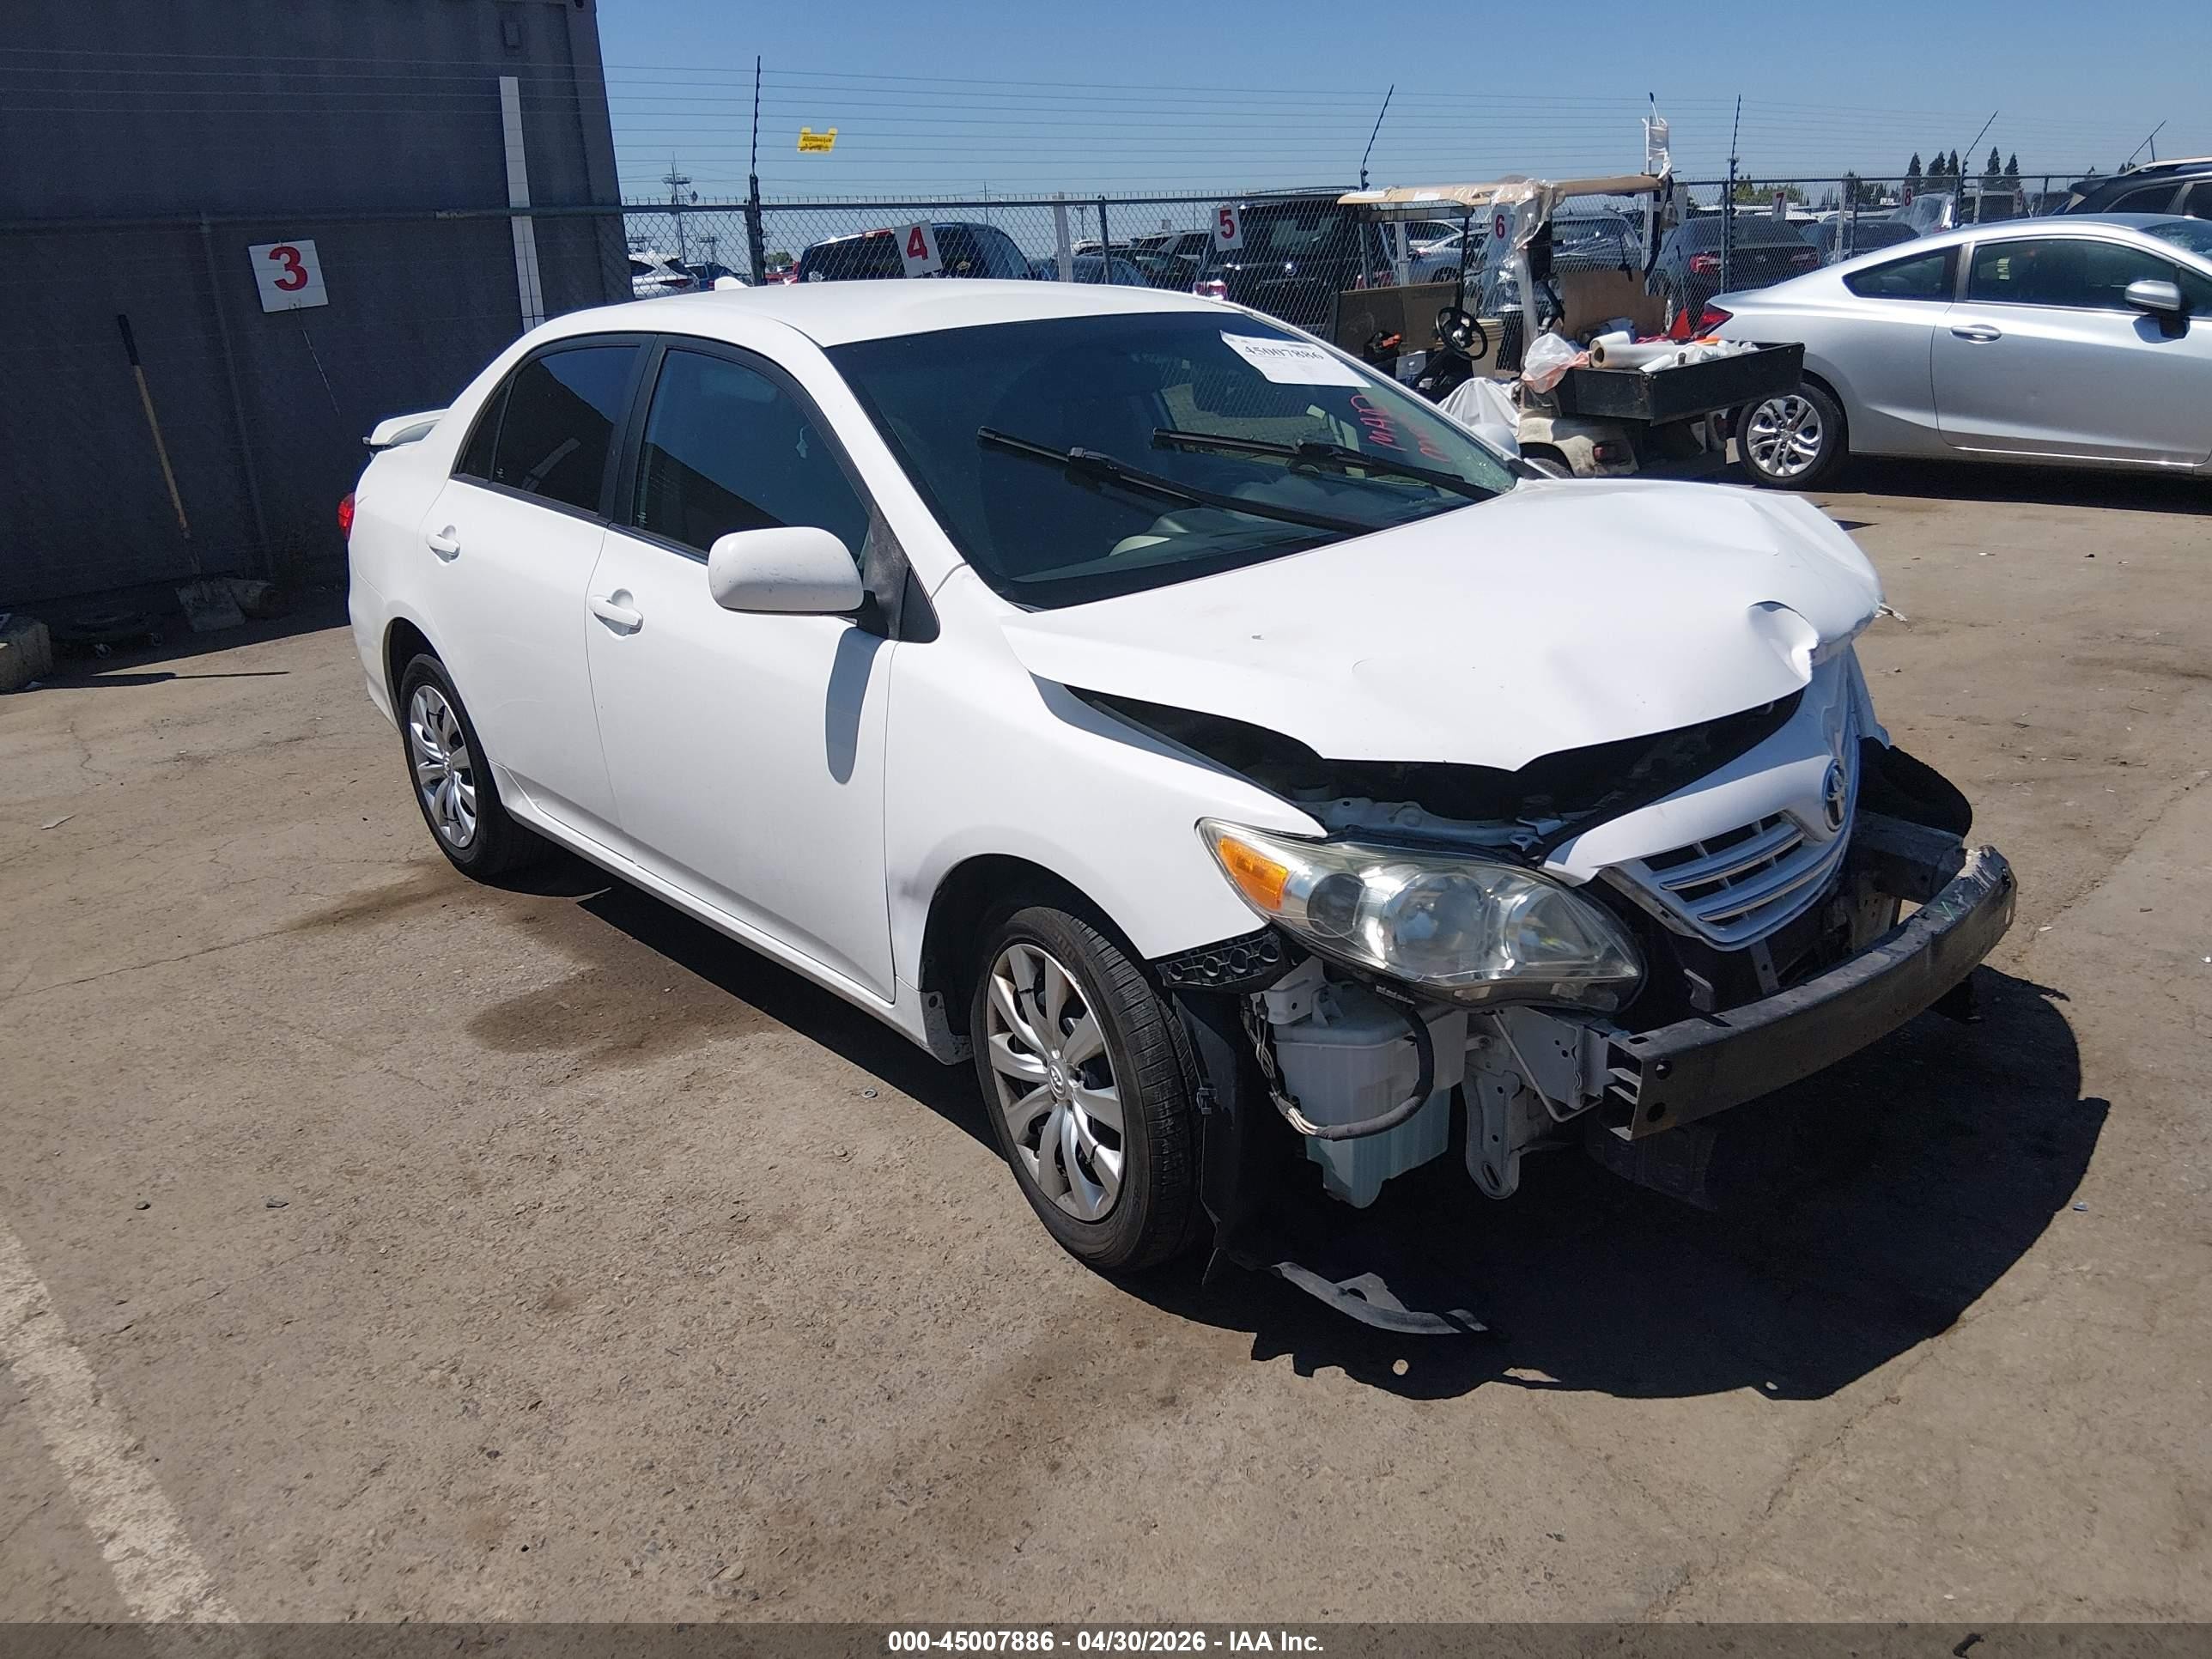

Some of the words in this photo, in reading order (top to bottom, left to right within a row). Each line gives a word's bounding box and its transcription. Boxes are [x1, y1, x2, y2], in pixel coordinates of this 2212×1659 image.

[1776, 191, 1784, 213] 7
[1905, 188, 1911, 206] 8
[1219, 210, 1235, 239] 5
[1495, 214, 1504, 239] 6
[907, 227, 928, 260] 4
[269, 246, 308, 291] 3
[1245, 346, 1324, 360] 45007886
